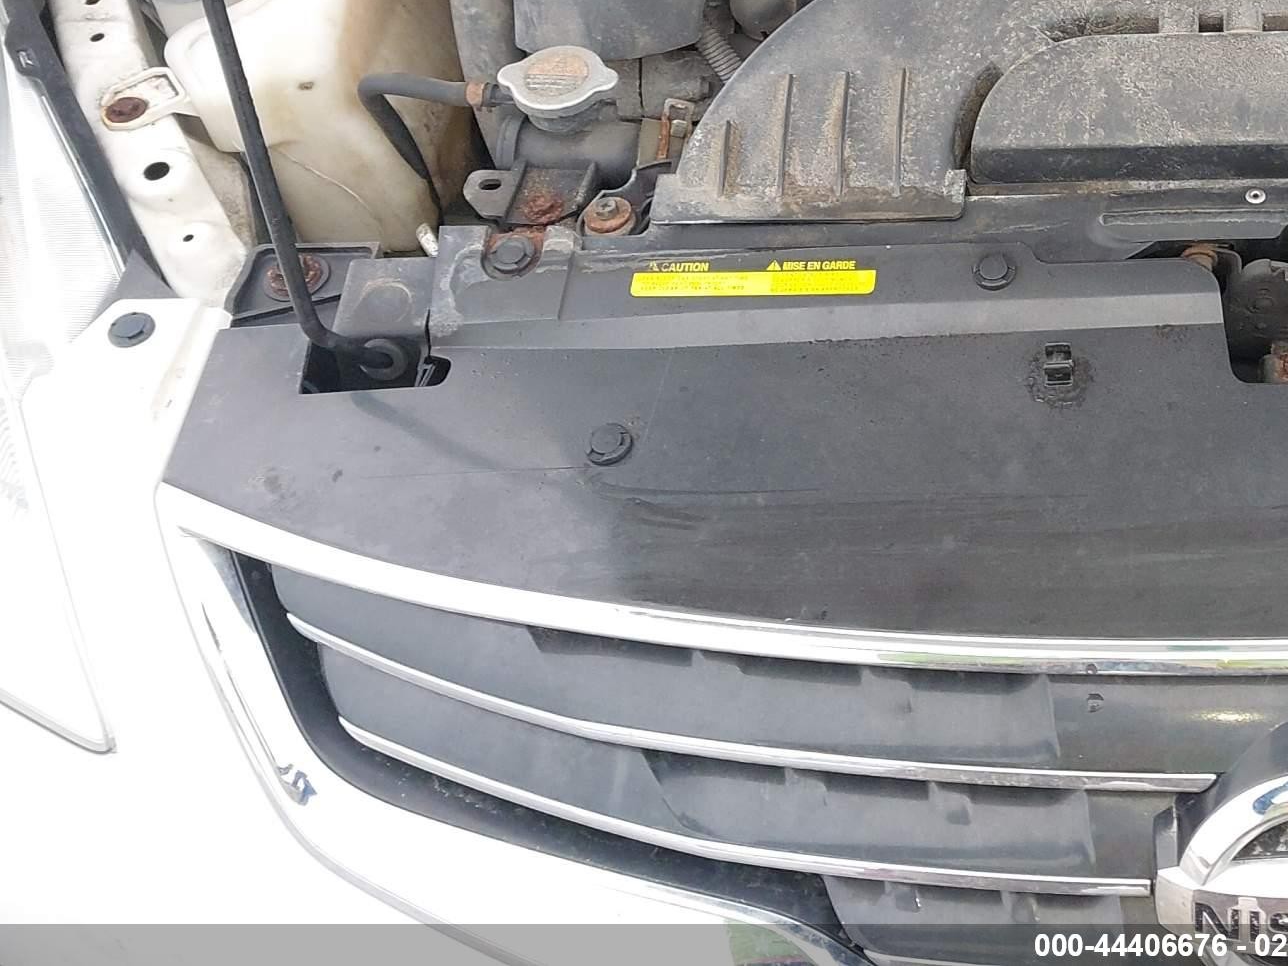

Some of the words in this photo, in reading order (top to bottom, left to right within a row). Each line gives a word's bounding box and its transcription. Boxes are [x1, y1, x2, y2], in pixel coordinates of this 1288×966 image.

[661, 262, 709, 272] CAUTION
[782, 261, 806, 270] MISE
[807, 261, 821, 270] EN
[822, 260, 856, 270] GARDE
